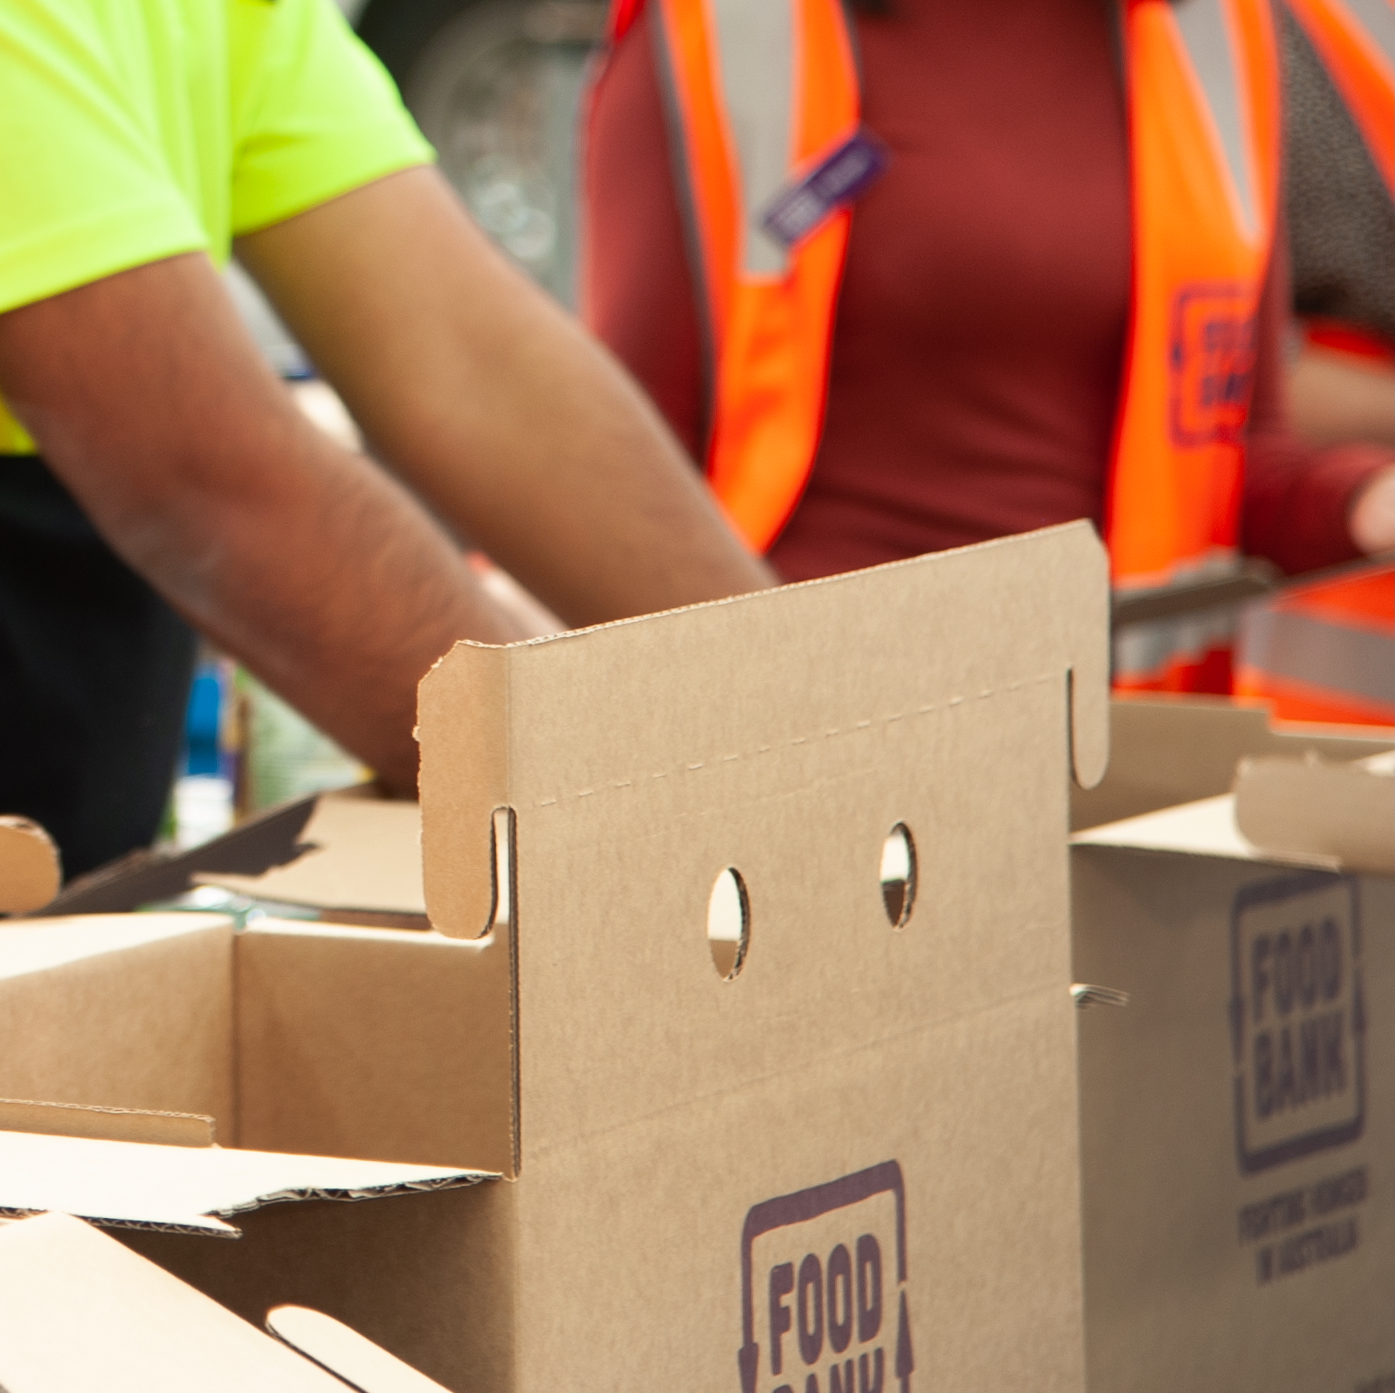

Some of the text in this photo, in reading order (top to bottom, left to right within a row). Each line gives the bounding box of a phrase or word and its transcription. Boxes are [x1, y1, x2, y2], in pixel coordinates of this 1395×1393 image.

[1252, 916, 1343, 1026] FOOD
[1254, 1012, 1348, 1120] BANK
[770, 1232, 883, 1377] FOOD
